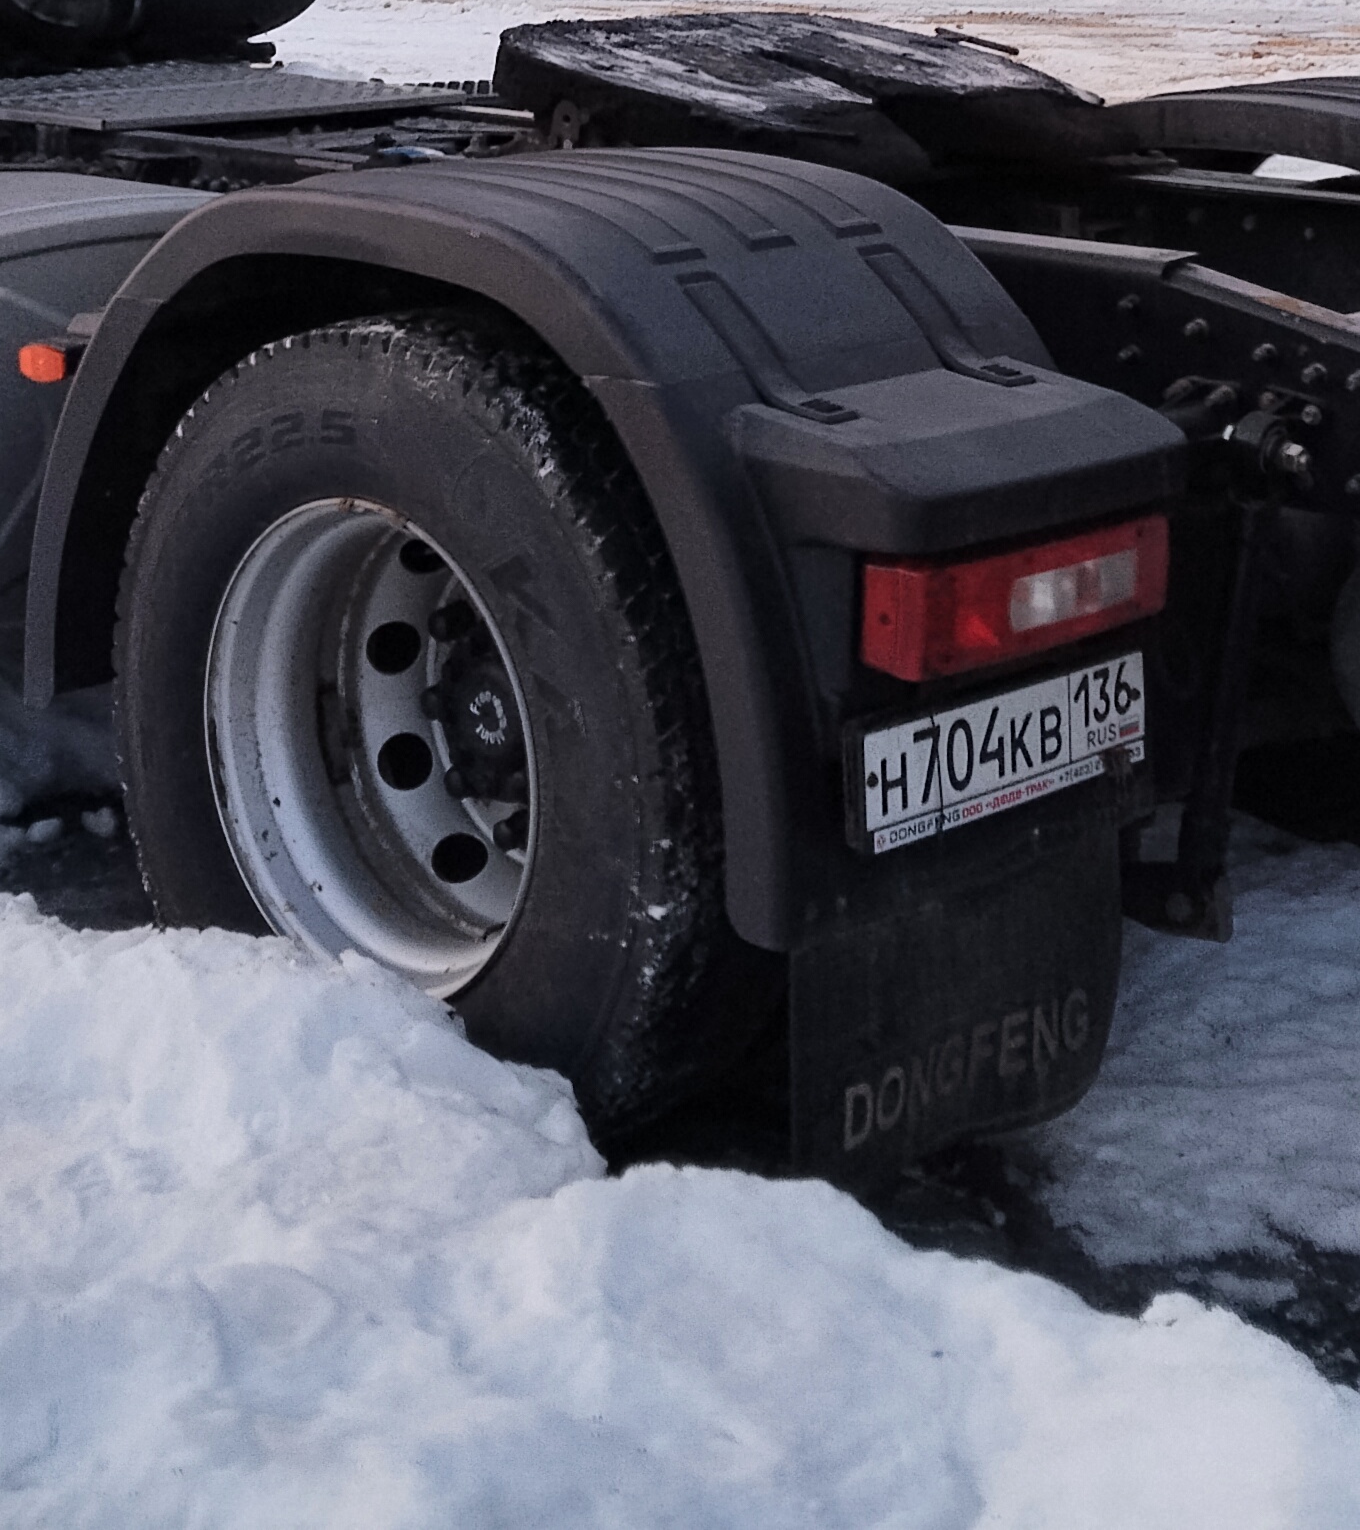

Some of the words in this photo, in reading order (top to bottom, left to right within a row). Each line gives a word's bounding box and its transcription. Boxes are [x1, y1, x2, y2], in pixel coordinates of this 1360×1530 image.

[1073, 661, 1133, 728] 136
[1087, 723, 1117, 750] RUS
[842, 987, 1090, 1153] DONGFENG
